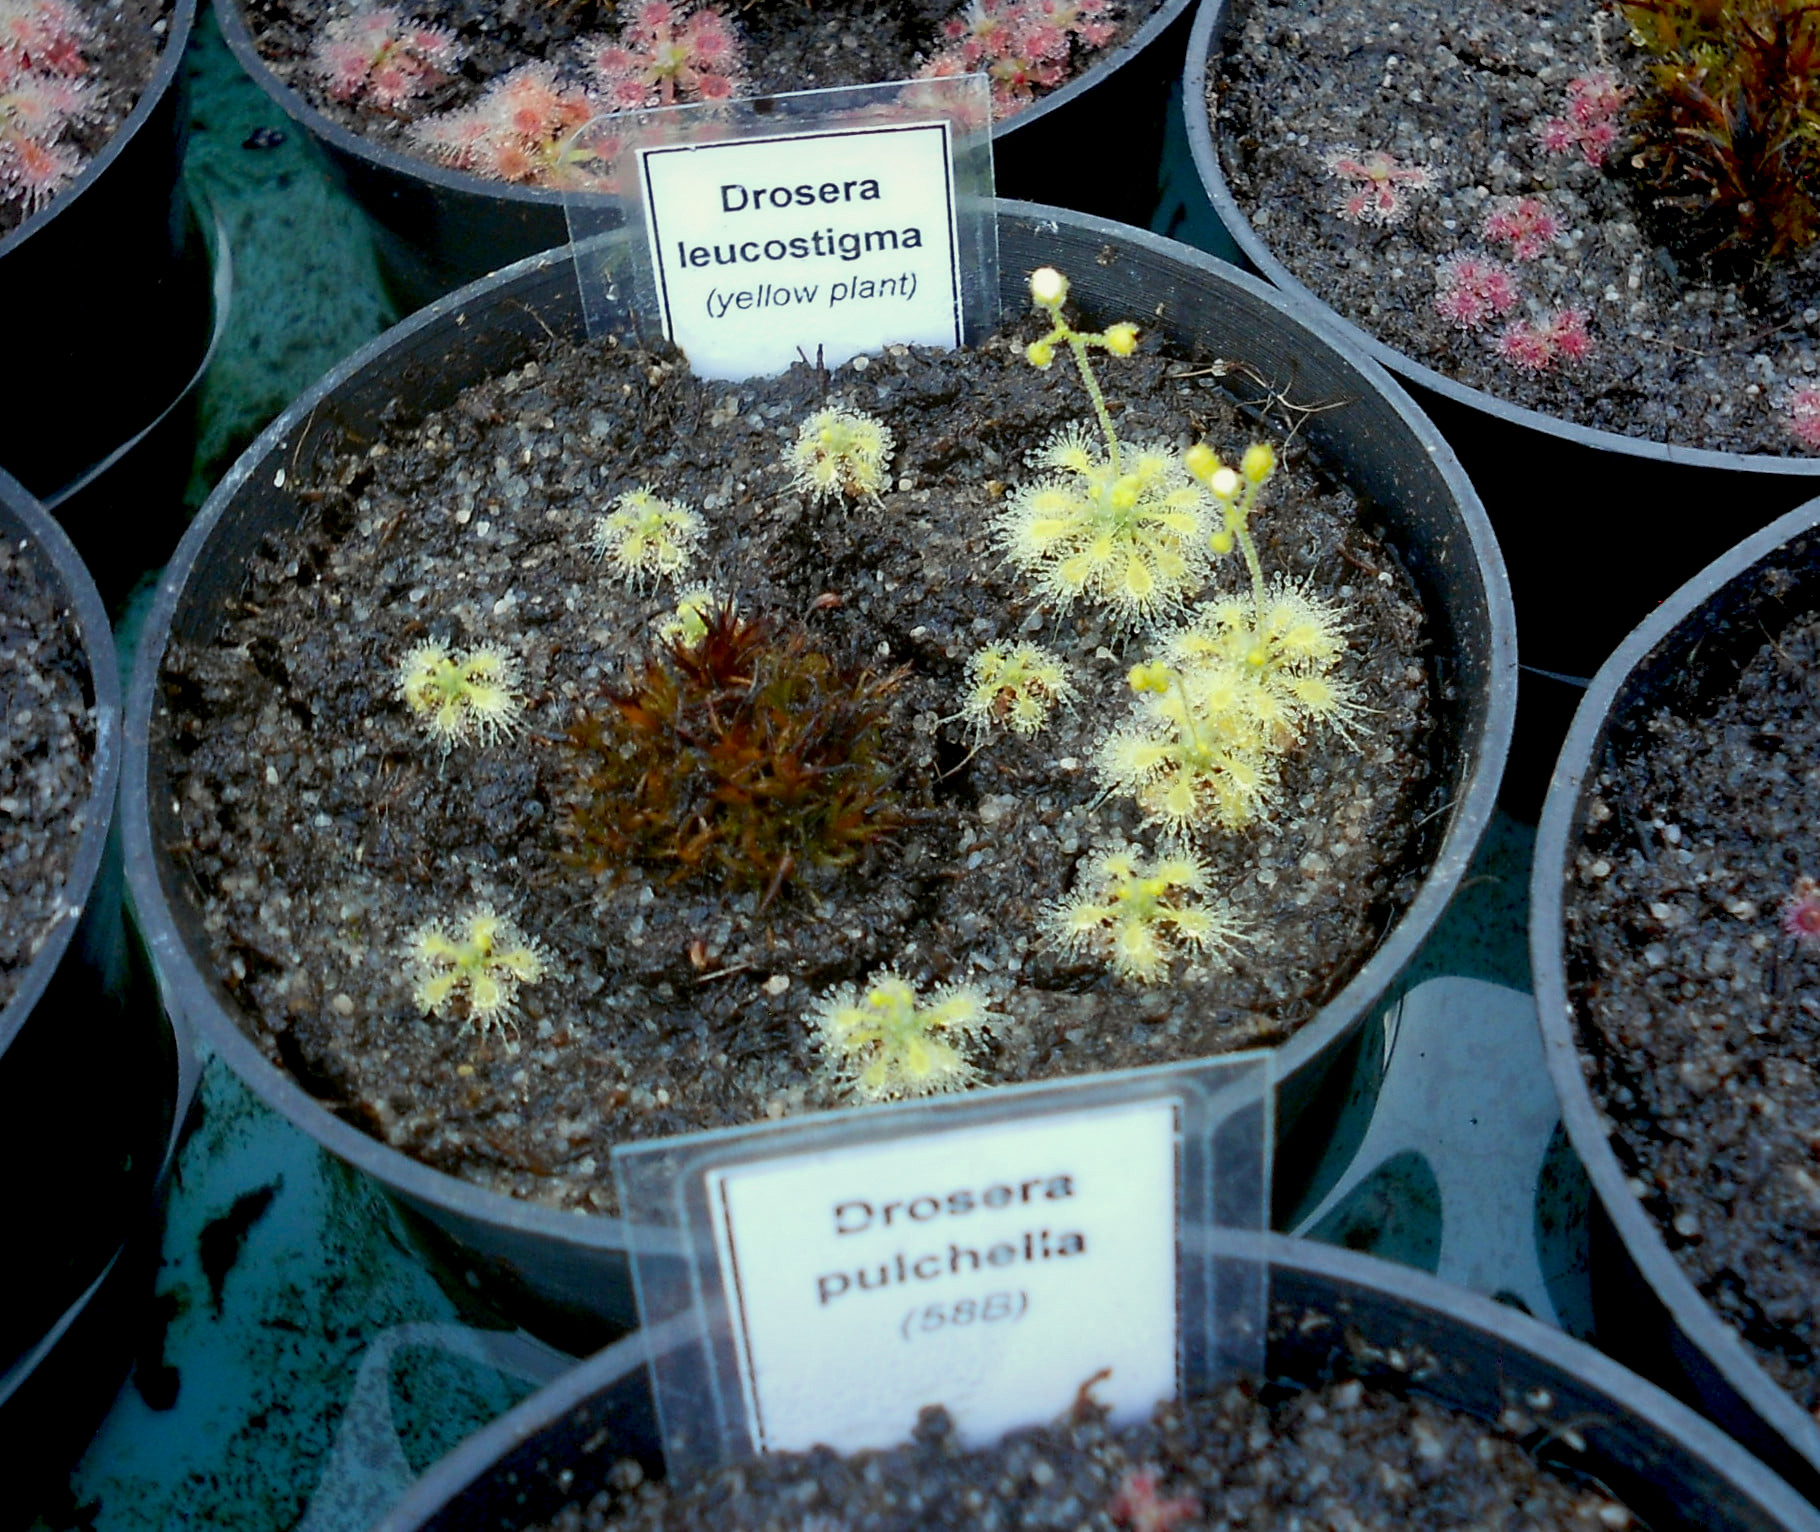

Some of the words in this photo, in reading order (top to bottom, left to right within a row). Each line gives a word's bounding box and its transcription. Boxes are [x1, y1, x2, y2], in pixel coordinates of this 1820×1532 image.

[721, 178, 881, 212] Drosera
[677, 227, 923, 268] leucostigma
[707, 284, 818, 318] (yellow
[830, 272, 918, 307] plant)
[834, 1173, 1073, 1235] Drosera
[817, 1229, 1086, 1305] pulchella
